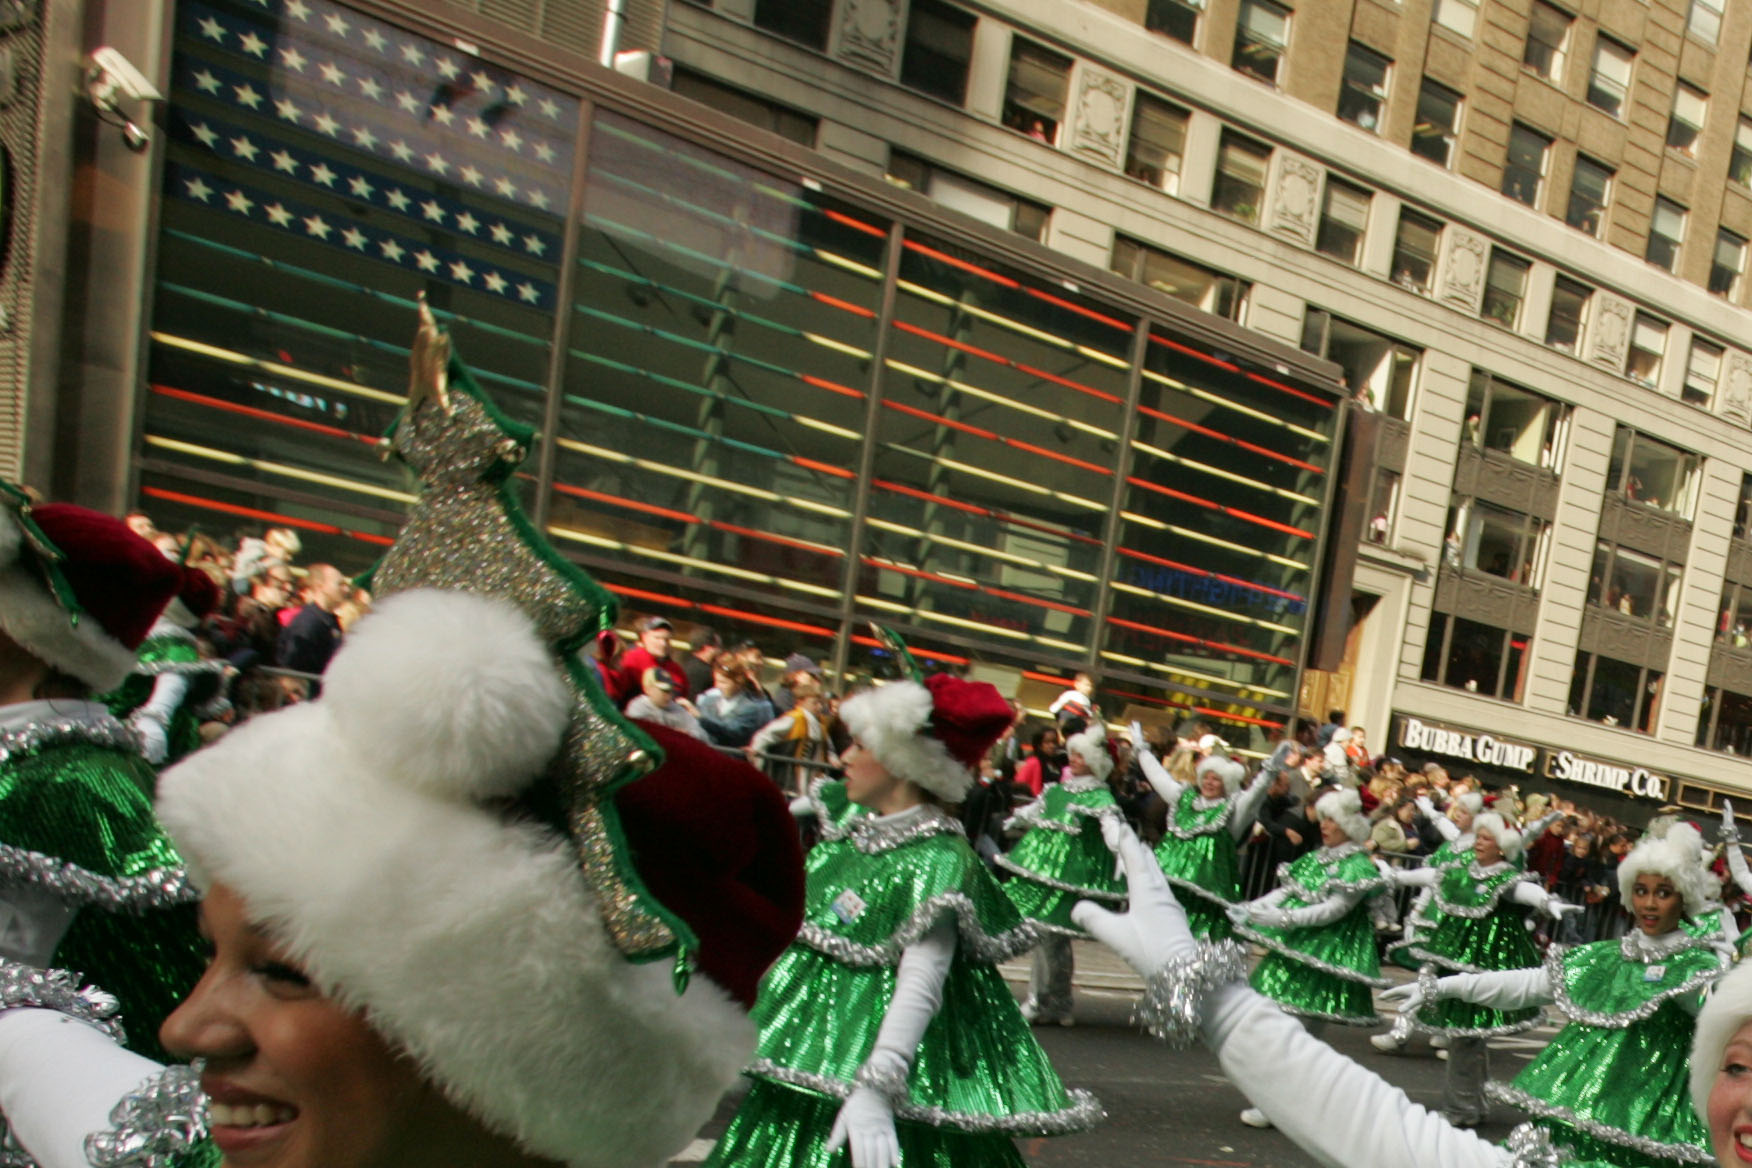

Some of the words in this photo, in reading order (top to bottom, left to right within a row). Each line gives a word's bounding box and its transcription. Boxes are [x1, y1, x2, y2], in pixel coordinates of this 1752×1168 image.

[1405, 719, 1473, 759] BUBBA
[1477, 735, 1535, 770] GUMP
[1555, 751, 1630, 791] SHRIMP
[1631, 767, 1664, 799] CO.
